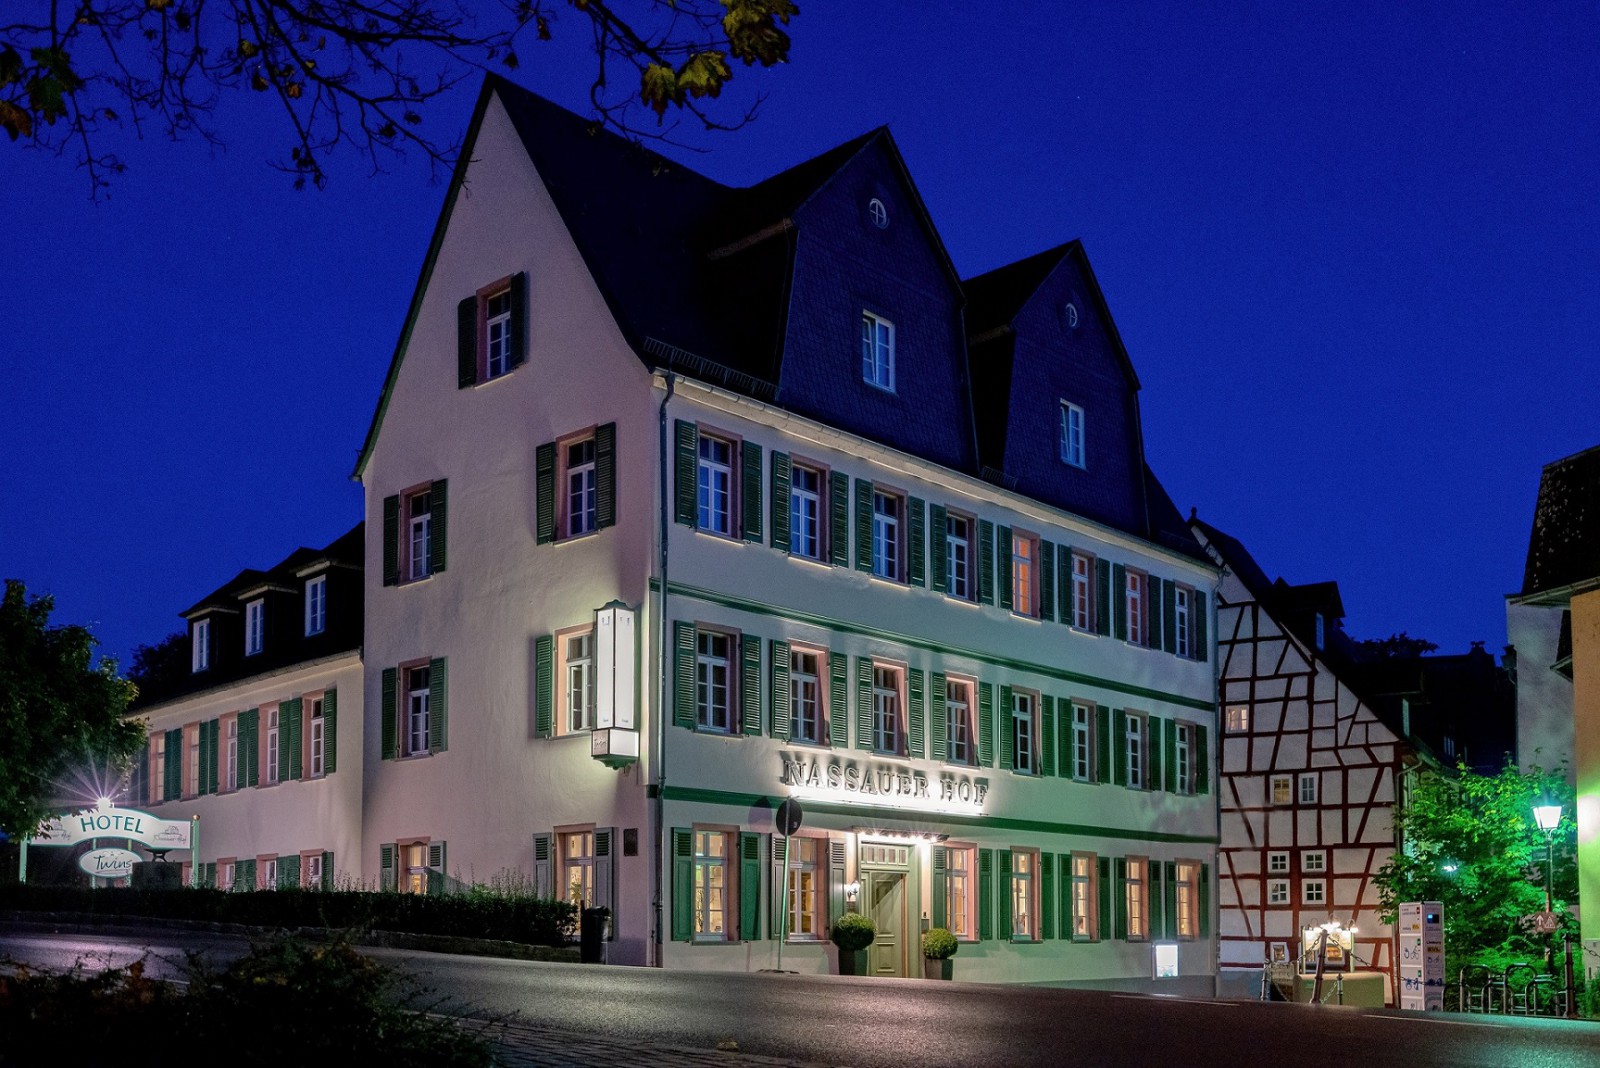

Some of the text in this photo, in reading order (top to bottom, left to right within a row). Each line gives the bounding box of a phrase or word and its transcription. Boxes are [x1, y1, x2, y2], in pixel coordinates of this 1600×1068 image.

[784, 760, 989, 806] NASSAUER HOF
[81, 815, 144, 834] HOTEL
[93, 855, 133, 870] Twins
